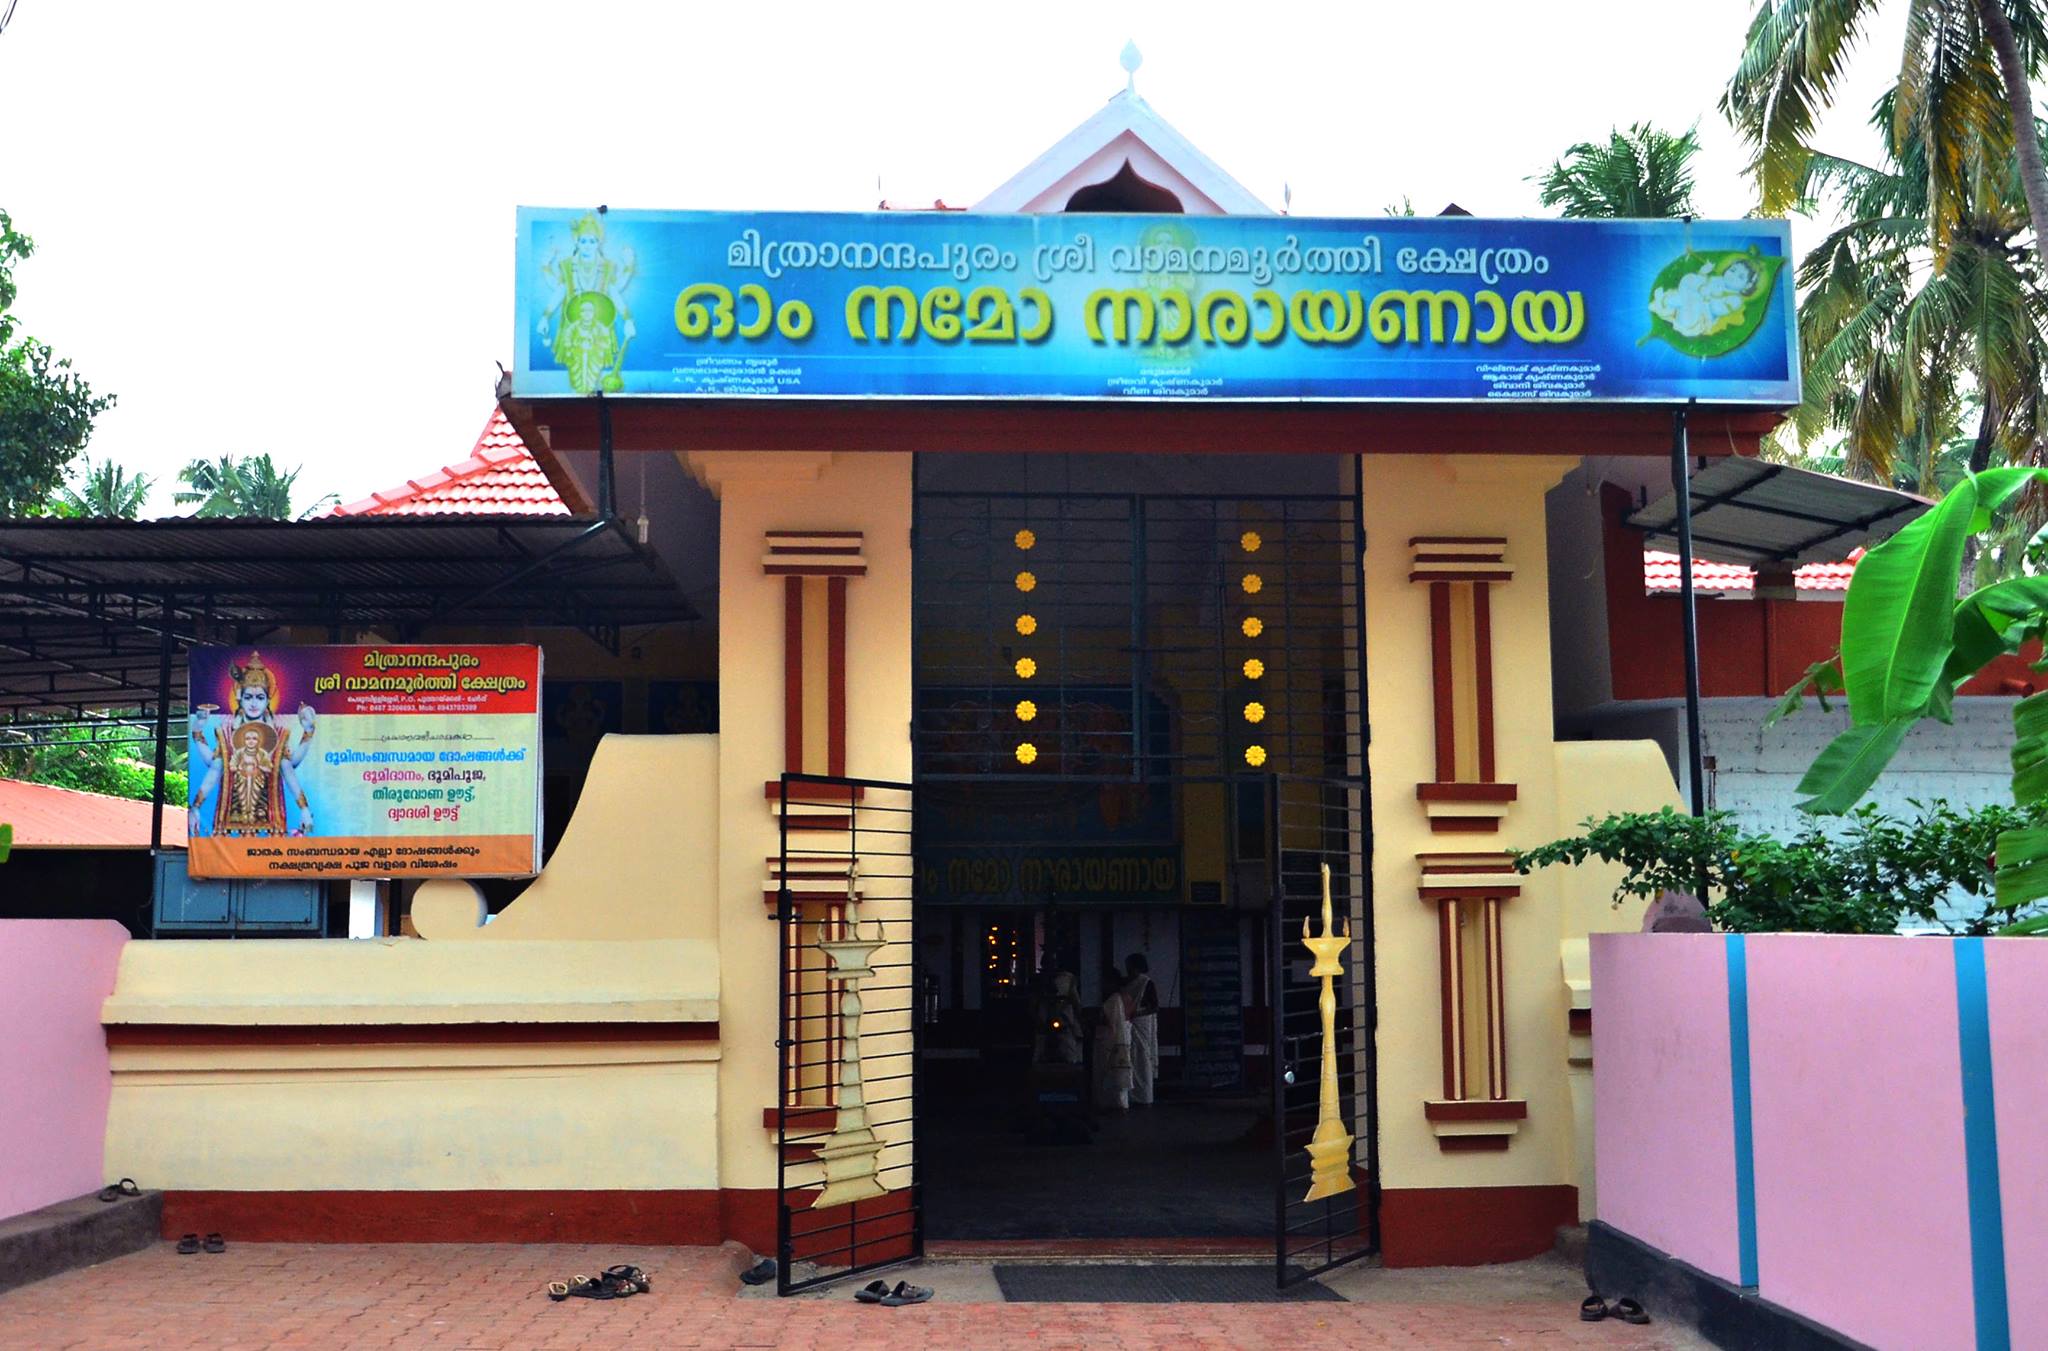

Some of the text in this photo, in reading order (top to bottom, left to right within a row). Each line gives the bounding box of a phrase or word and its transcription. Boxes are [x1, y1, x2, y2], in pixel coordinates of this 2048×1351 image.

[727, 229, 1549, 285] മിത്രാനന്ദപുരം ശ്രീ വാമനമൂർത്തി ക്ഷേത്രം
[674, 283, 1585, 345] ഓം നമോ നാരായണായ
[364, 651, 480, 670] മിത്രാനന്ദപുരം
[314, 673, 340, 694] ശ്രീ
[461, 675, 526, 693] ക്ഷേത്രം
[324, 748, 526, 765] ഭൂമിസംബന്ധമായ ദോഷങ്ങൾക്ക്
[362, 768, 425, 784] ഭൂമിദാനം,
[372, 787, 443, 803] തിരുവോണ
[433, 805, 460, 821] ഊട്ട്
[247, 845, 480, 858] ജാതക സംബന്ധമായ എല്ലാ ദോഷങ്ങൾക്കും
[373, 860, 407, 870] വളരെ
[411, 858, 458, 870] വിശേഷം
